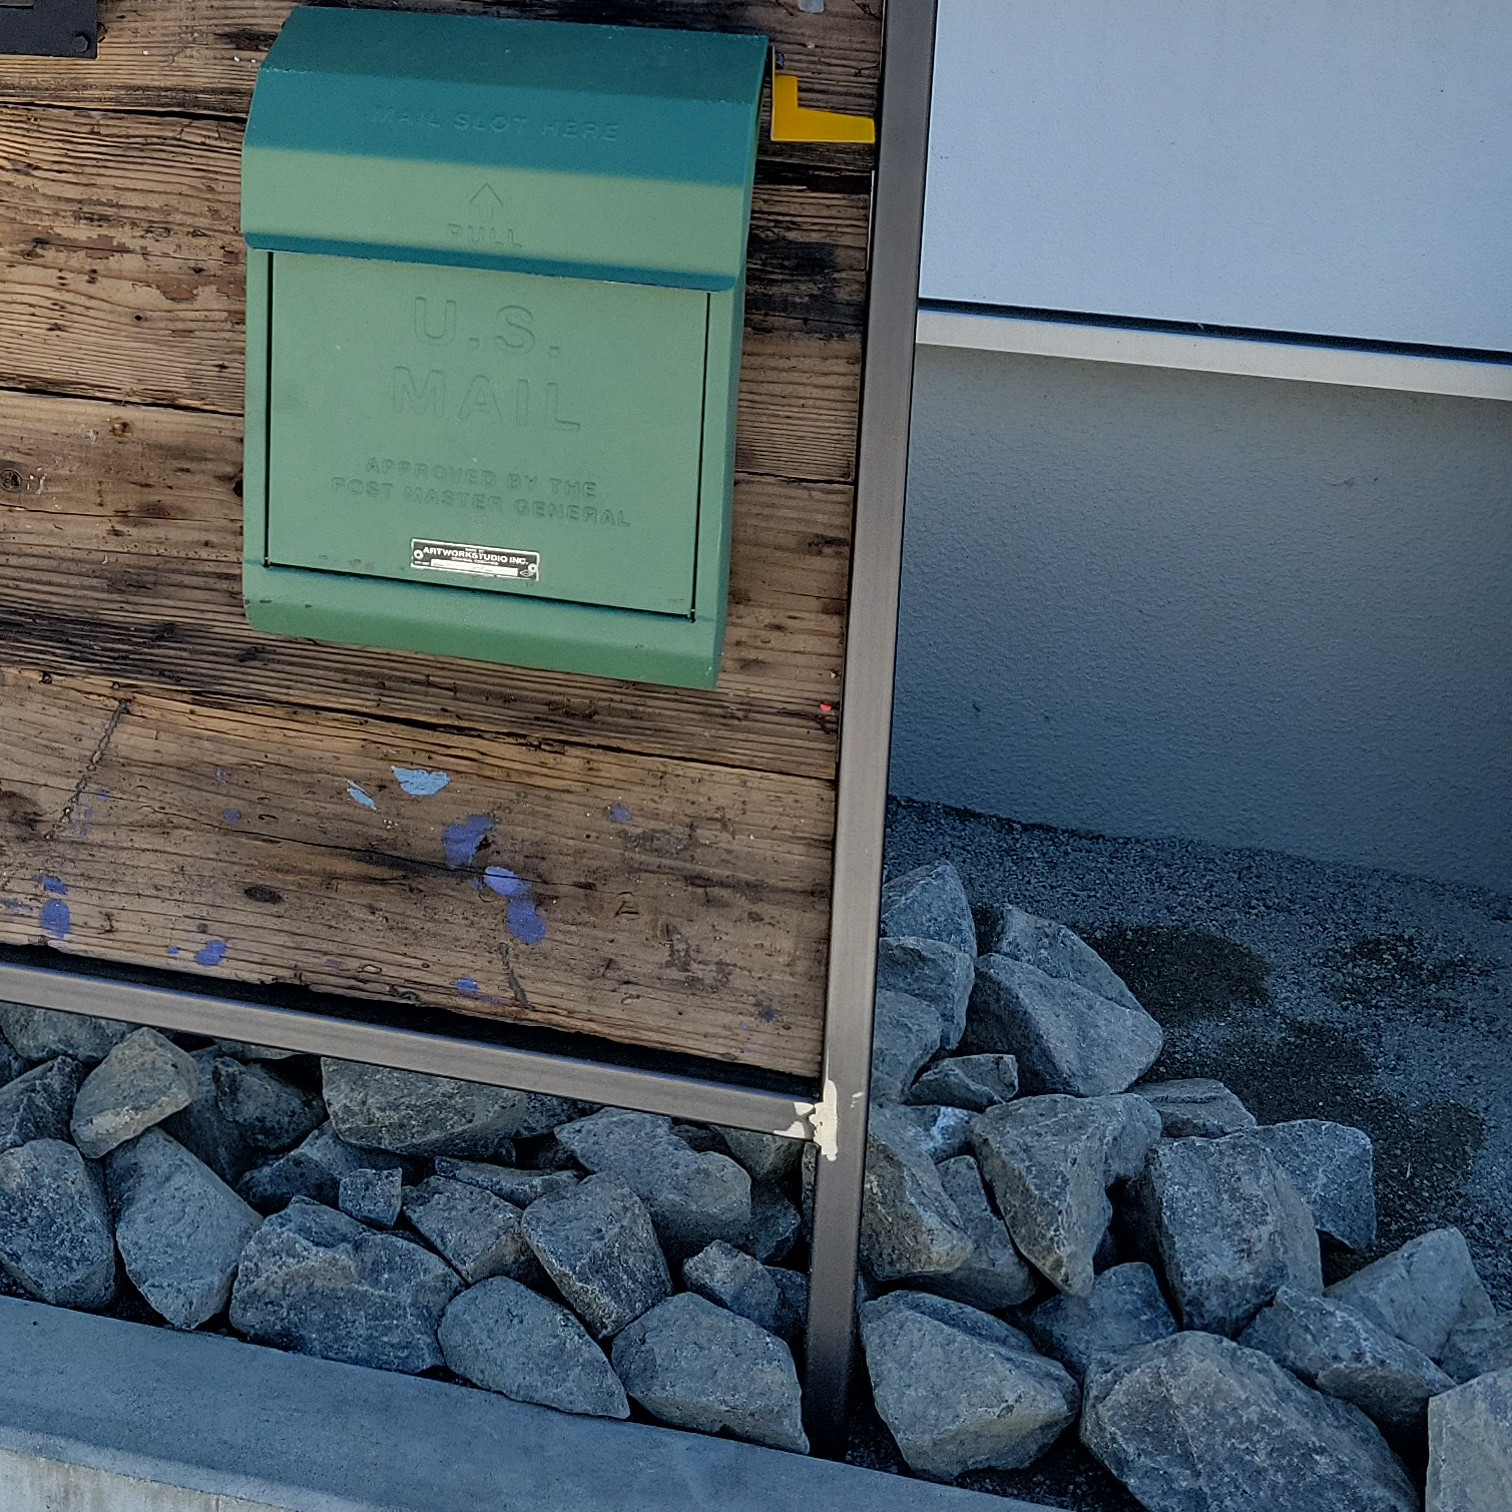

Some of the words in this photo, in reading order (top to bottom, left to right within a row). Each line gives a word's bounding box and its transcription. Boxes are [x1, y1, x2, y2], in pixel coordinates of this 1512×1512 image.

[453, 112, 528, 134] SLOT
[414, 296, 560, 358] U.S.
[393, 365, 581, 433] MAIL
[365, 457, 497, 487] APPROVED
[507, 472, 538, 491] BY
[548, 477, 598, 499] THE
[331, 476, 394, 499] POST
[402, 484, 504, 514] MASTER
[513, 497, 632, 529] GENERAL
[509, 556, 529, 565] INC.
